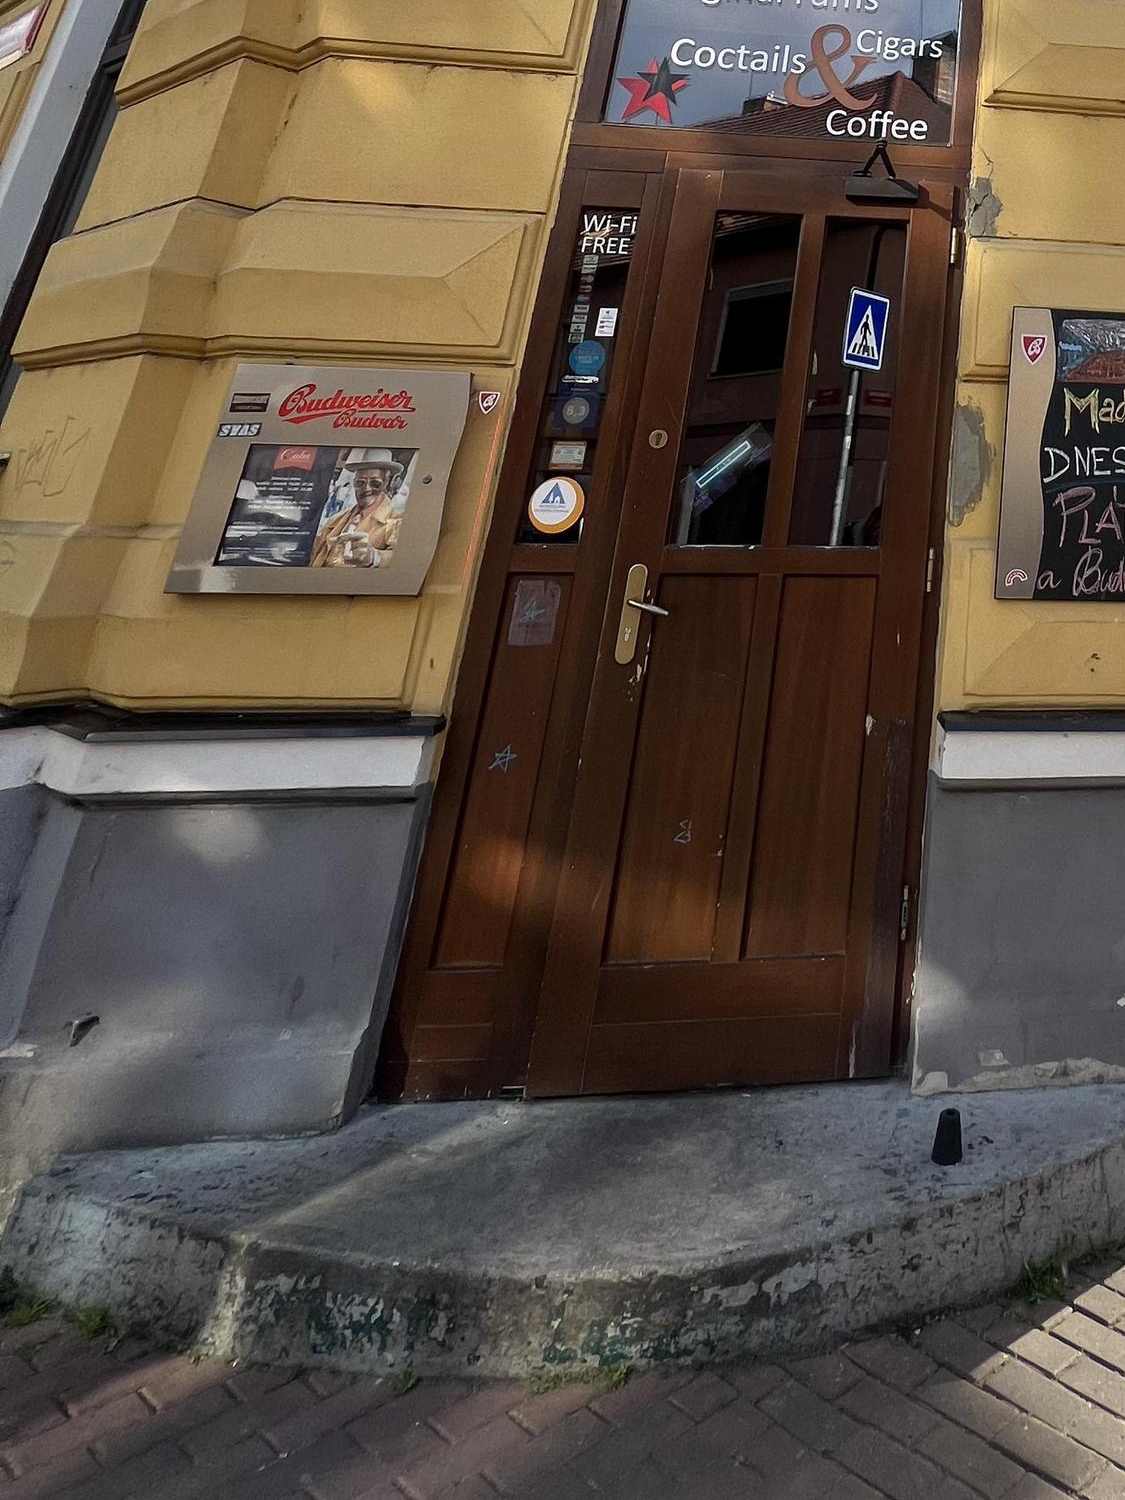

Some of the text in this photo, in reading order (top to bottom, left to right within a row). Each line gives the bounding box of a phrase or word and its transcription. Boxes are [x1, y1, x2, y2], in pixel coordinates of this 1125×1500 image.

[670, 24, 943, 109] Coctails & Cigars
[826, 109, 928, 140] Coffee
[583, 214, 637, 235] Wi-Fi
[581, 237, 630, 255] FREE
[279, 384, 416, 420] Budweiser
[333, 409, 408, 429] Budvar
